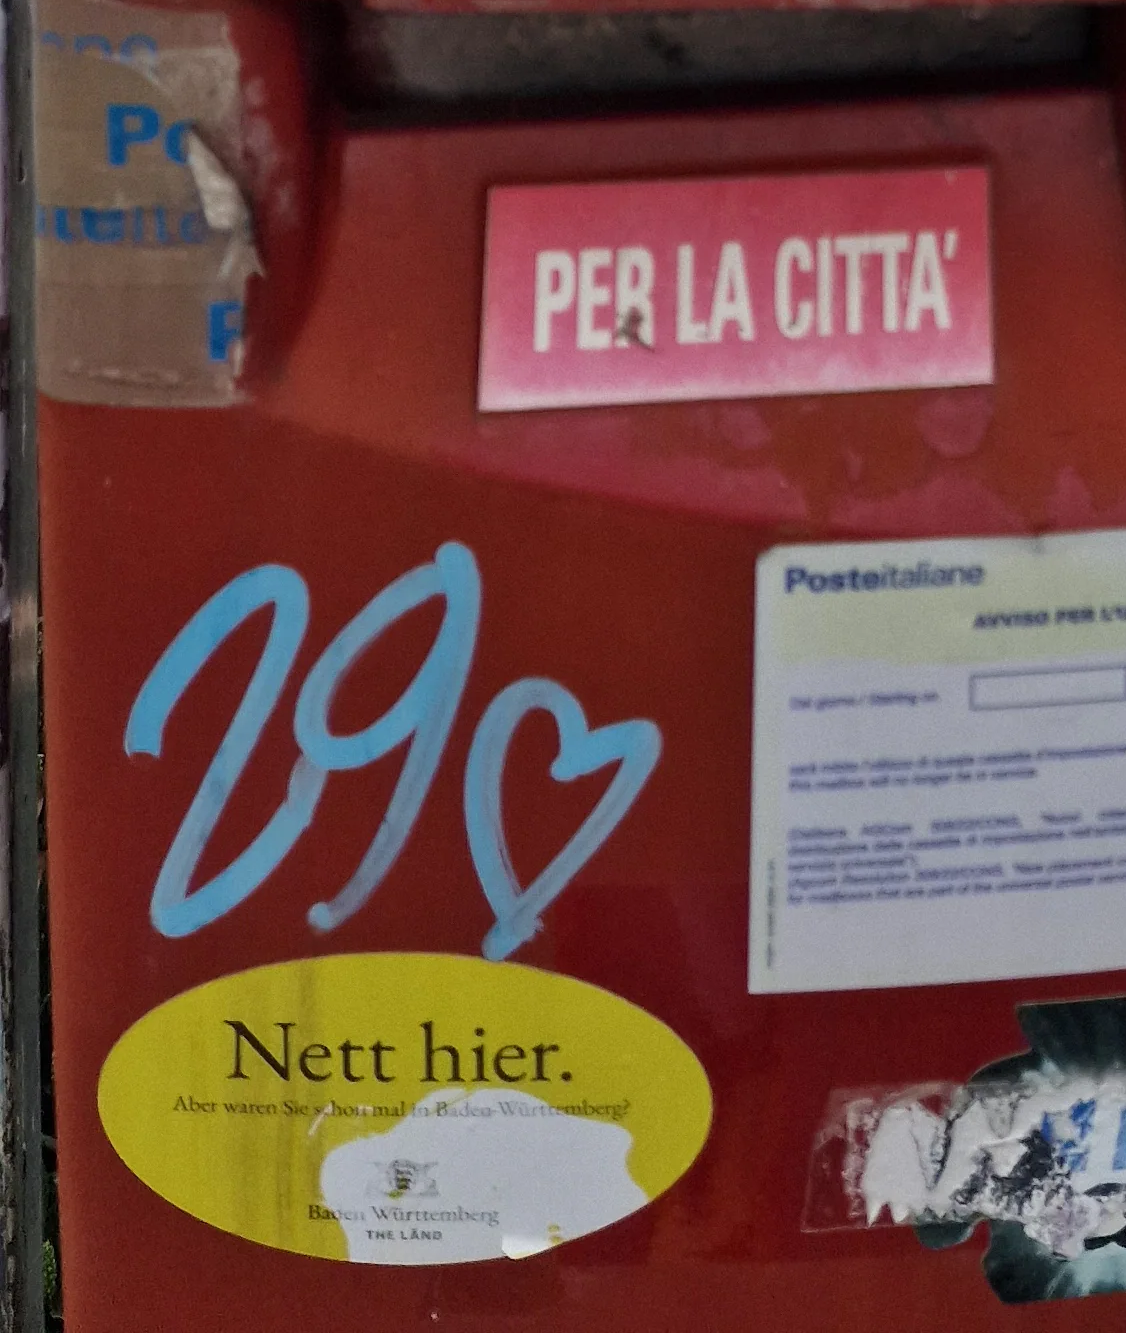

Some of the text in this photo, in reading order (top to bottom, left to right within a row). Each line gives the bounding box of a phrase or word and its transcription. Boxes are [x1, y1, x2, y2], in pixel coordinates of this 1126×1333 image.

[532, 245, 655, 353] PER
[676, 240, 755, 345] LA
[972, 609, 1049, 629] AVVISO
[1055, 607, 1096, 625] PER
[224, 1019, 575, 1083] Nett hier.
[173, 1095, 217, 1113] Aber
[224, 1100, 278, 1115] waren
[283, 1099, 309, 1116] Sie
[313, 1099, 369, 1118] shon
[372, 1101, 406, 1118] mal
[366, 1230, 395, 1241] THE
